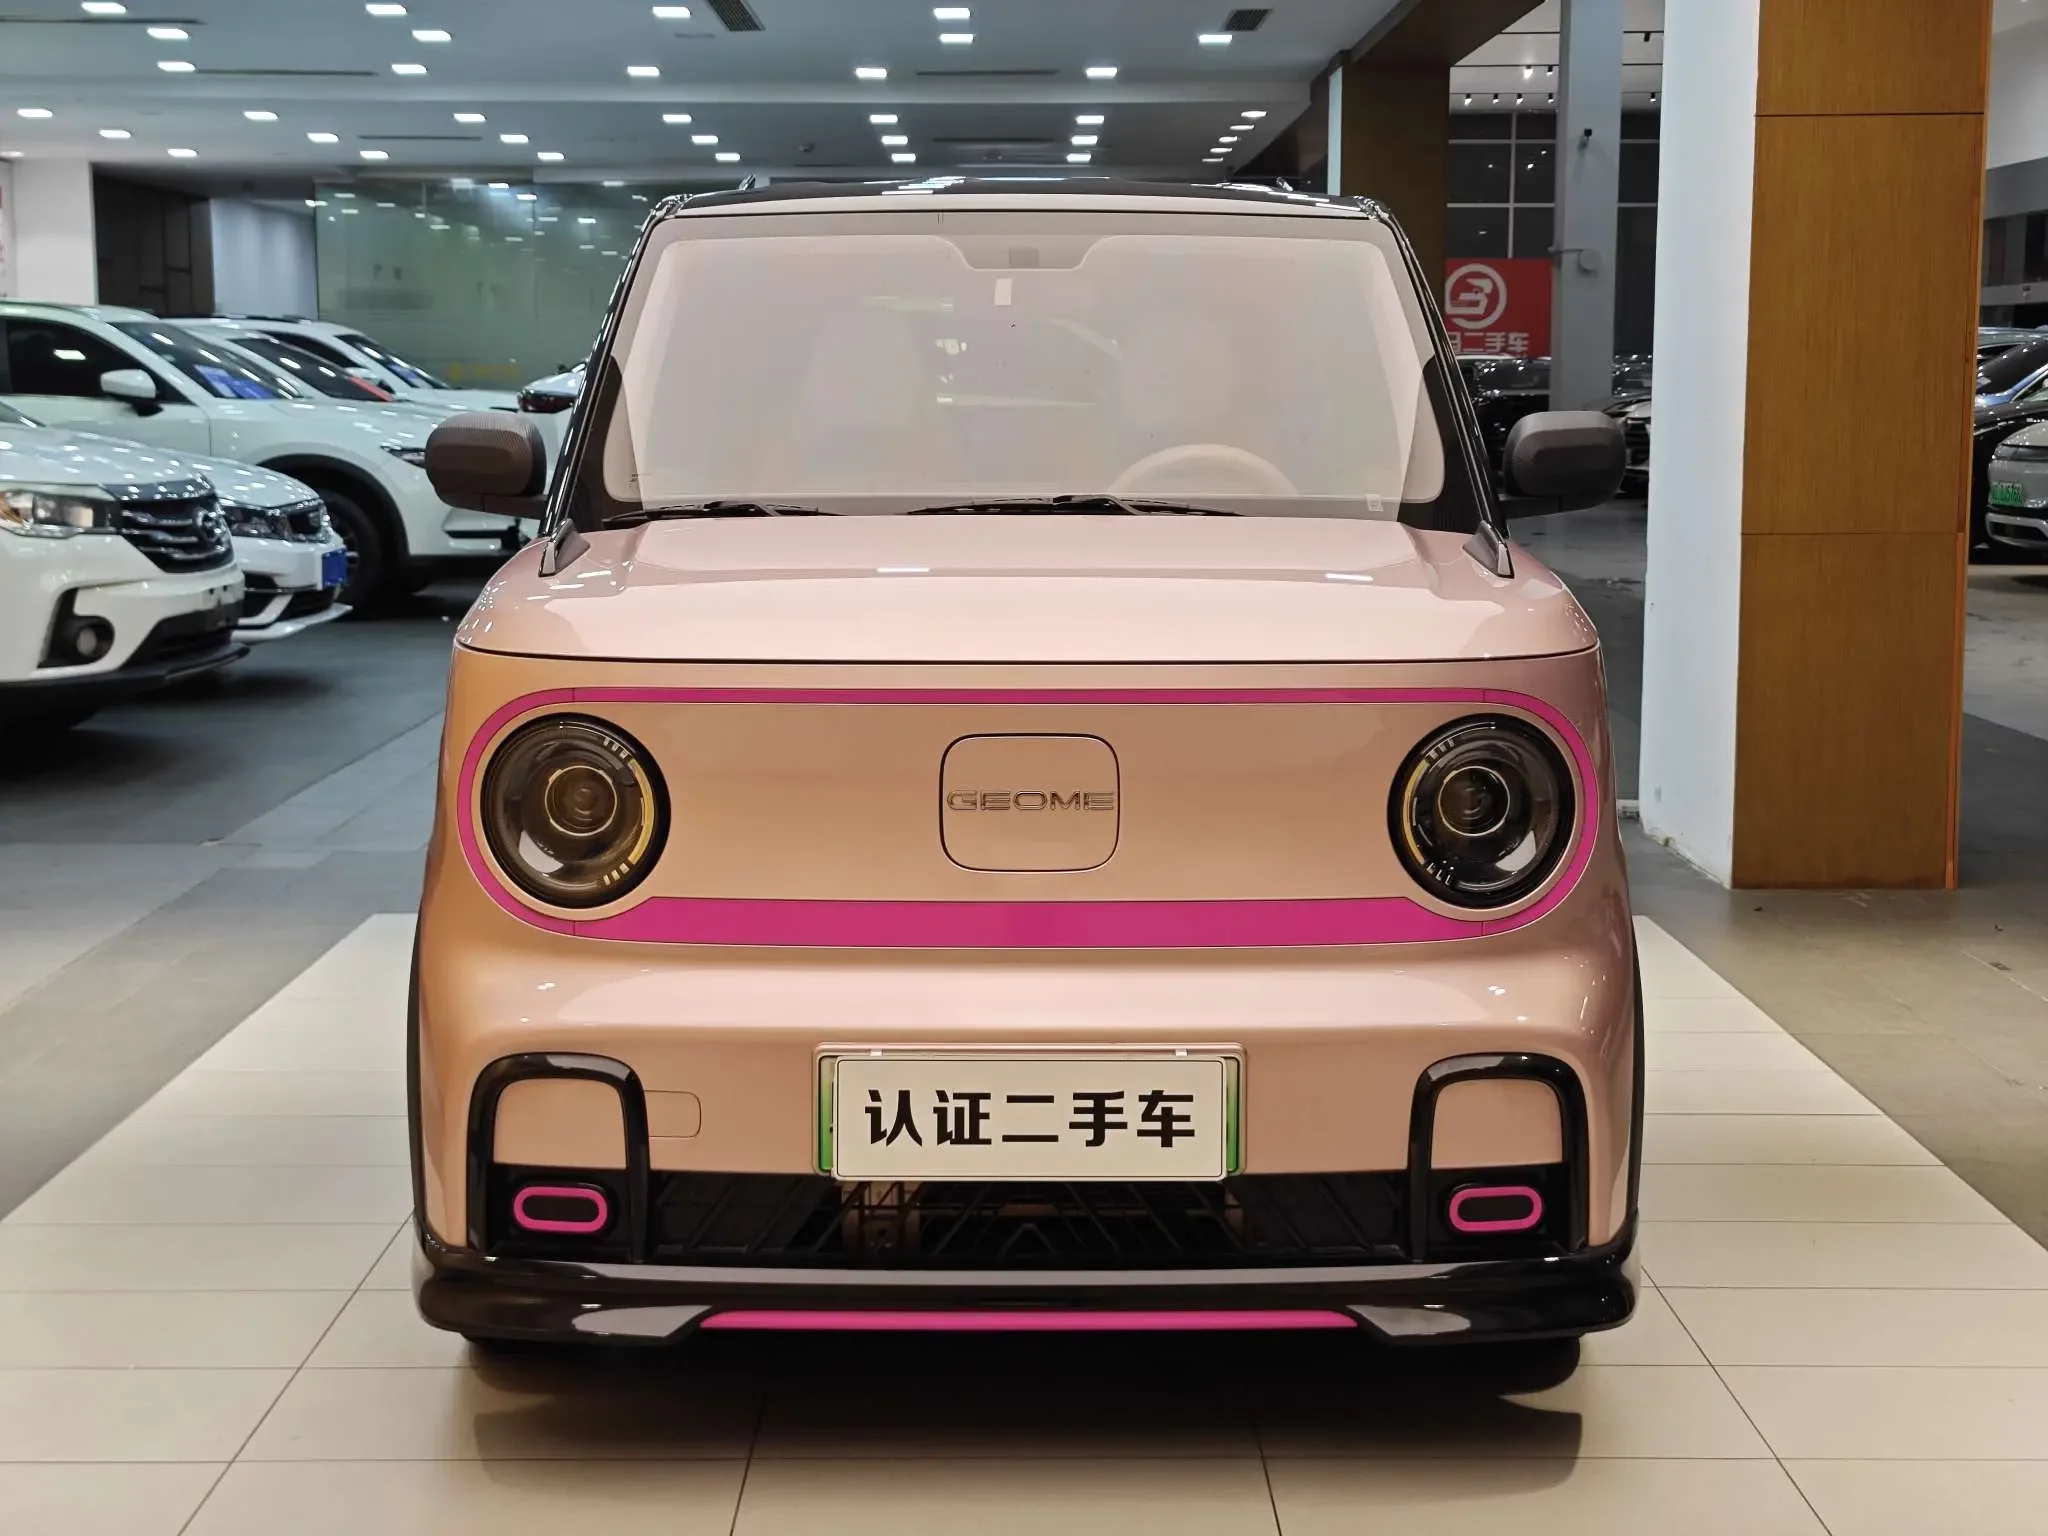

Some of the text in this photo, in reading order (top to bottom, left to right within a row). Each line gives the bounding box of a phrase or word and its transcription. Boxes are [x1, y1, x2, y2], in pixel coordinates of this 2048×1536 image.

[947, 789, 1114, 811] GEOME
[864, 1089, 1196, 1148] 认证二手车
